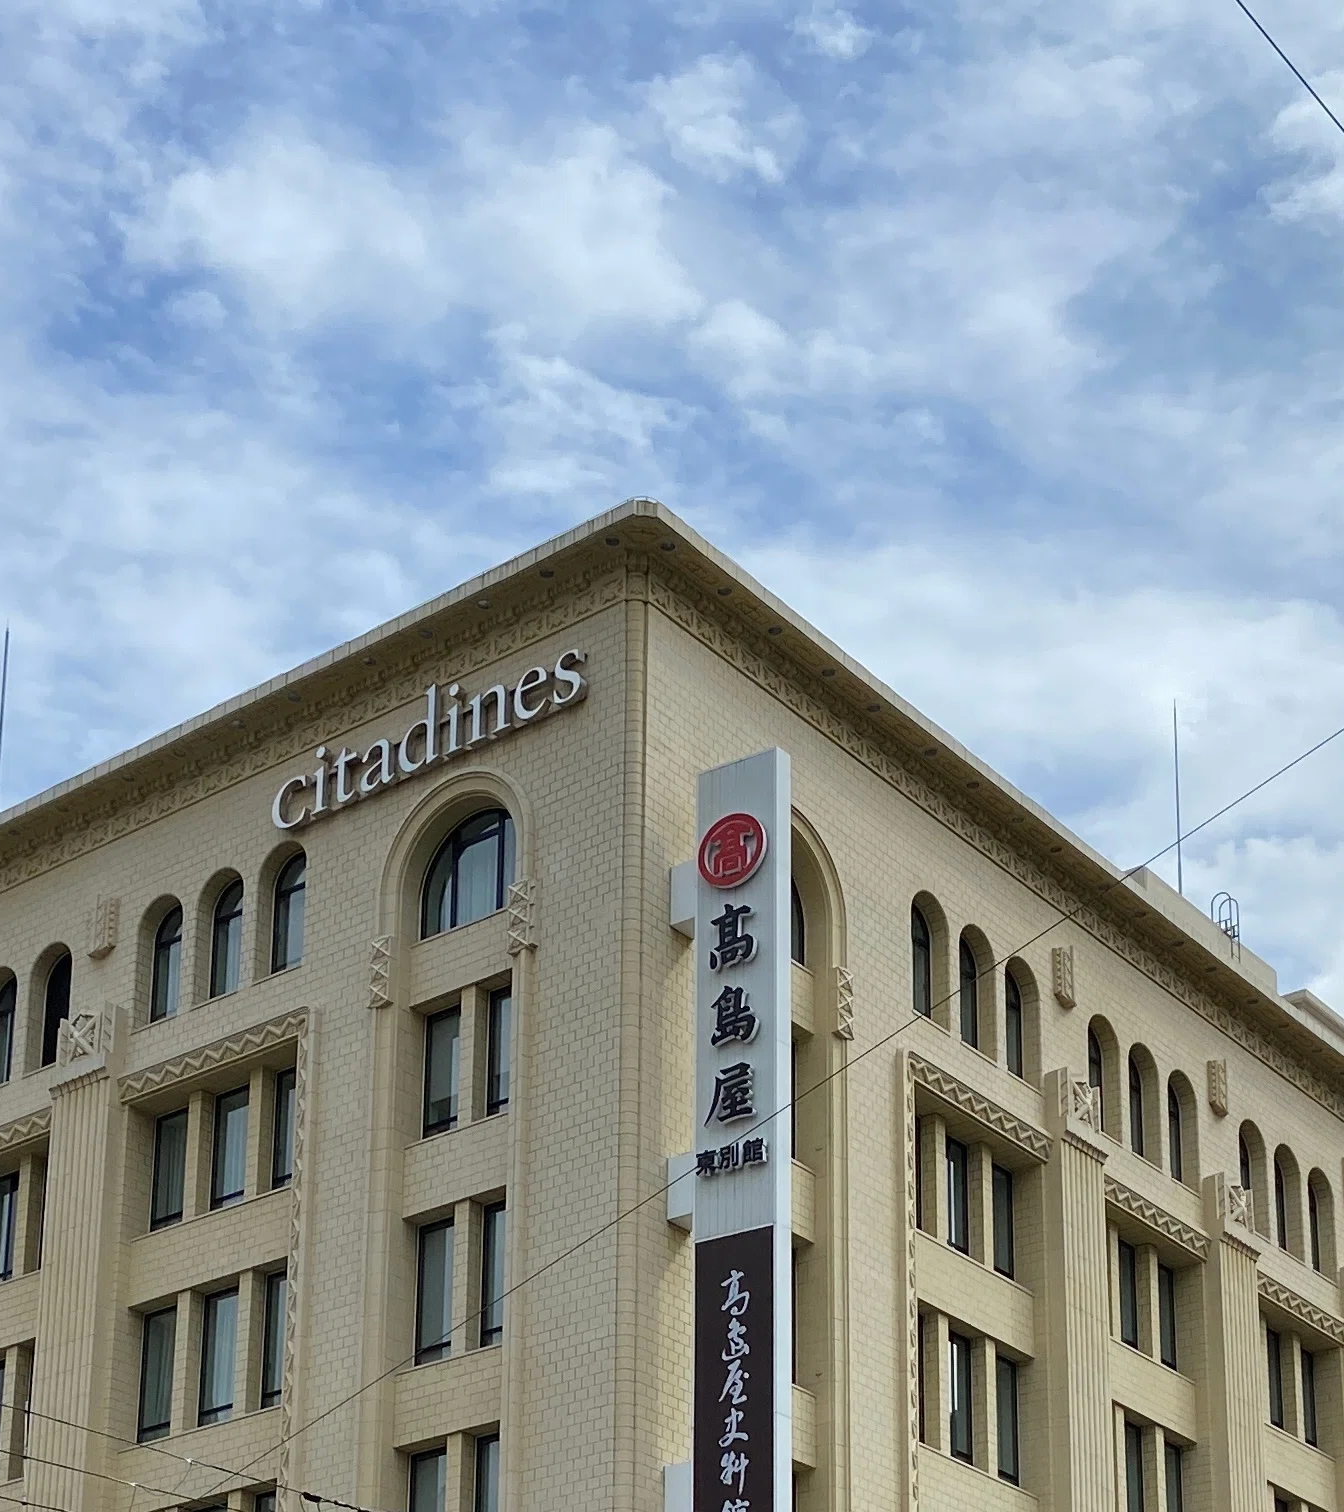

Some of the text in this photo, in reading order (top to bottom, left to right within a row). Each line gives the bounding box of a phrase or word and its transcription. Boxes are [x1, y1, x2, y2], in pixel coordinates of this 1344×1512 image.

[271, 648, 589, 830] citadines
[695, 1137, 767, 1177] 東別館
